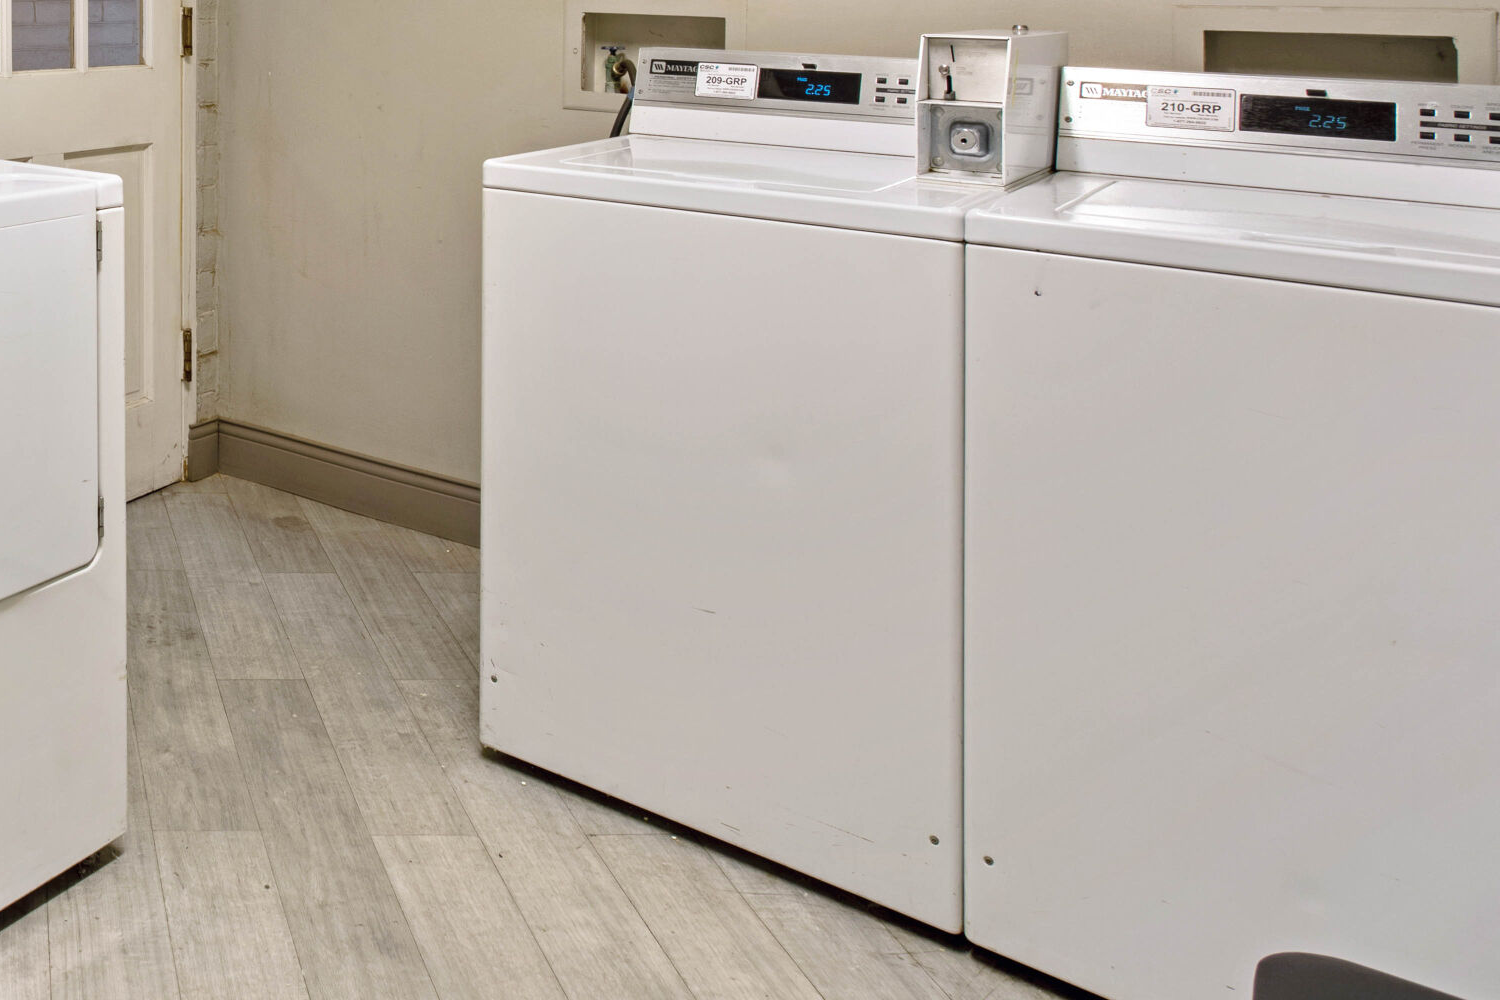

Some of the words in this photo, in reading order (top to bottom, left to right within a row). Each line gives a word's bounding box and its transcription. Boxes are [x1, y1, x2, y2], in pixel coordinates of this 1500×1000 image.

[706, 76, 747, 86] 209-GRP
[805, 84, 831, 96] 2.25
[1161, 102, 1222, 114] 210-GRP
[1308, 114, 1348, 129] 2.25
